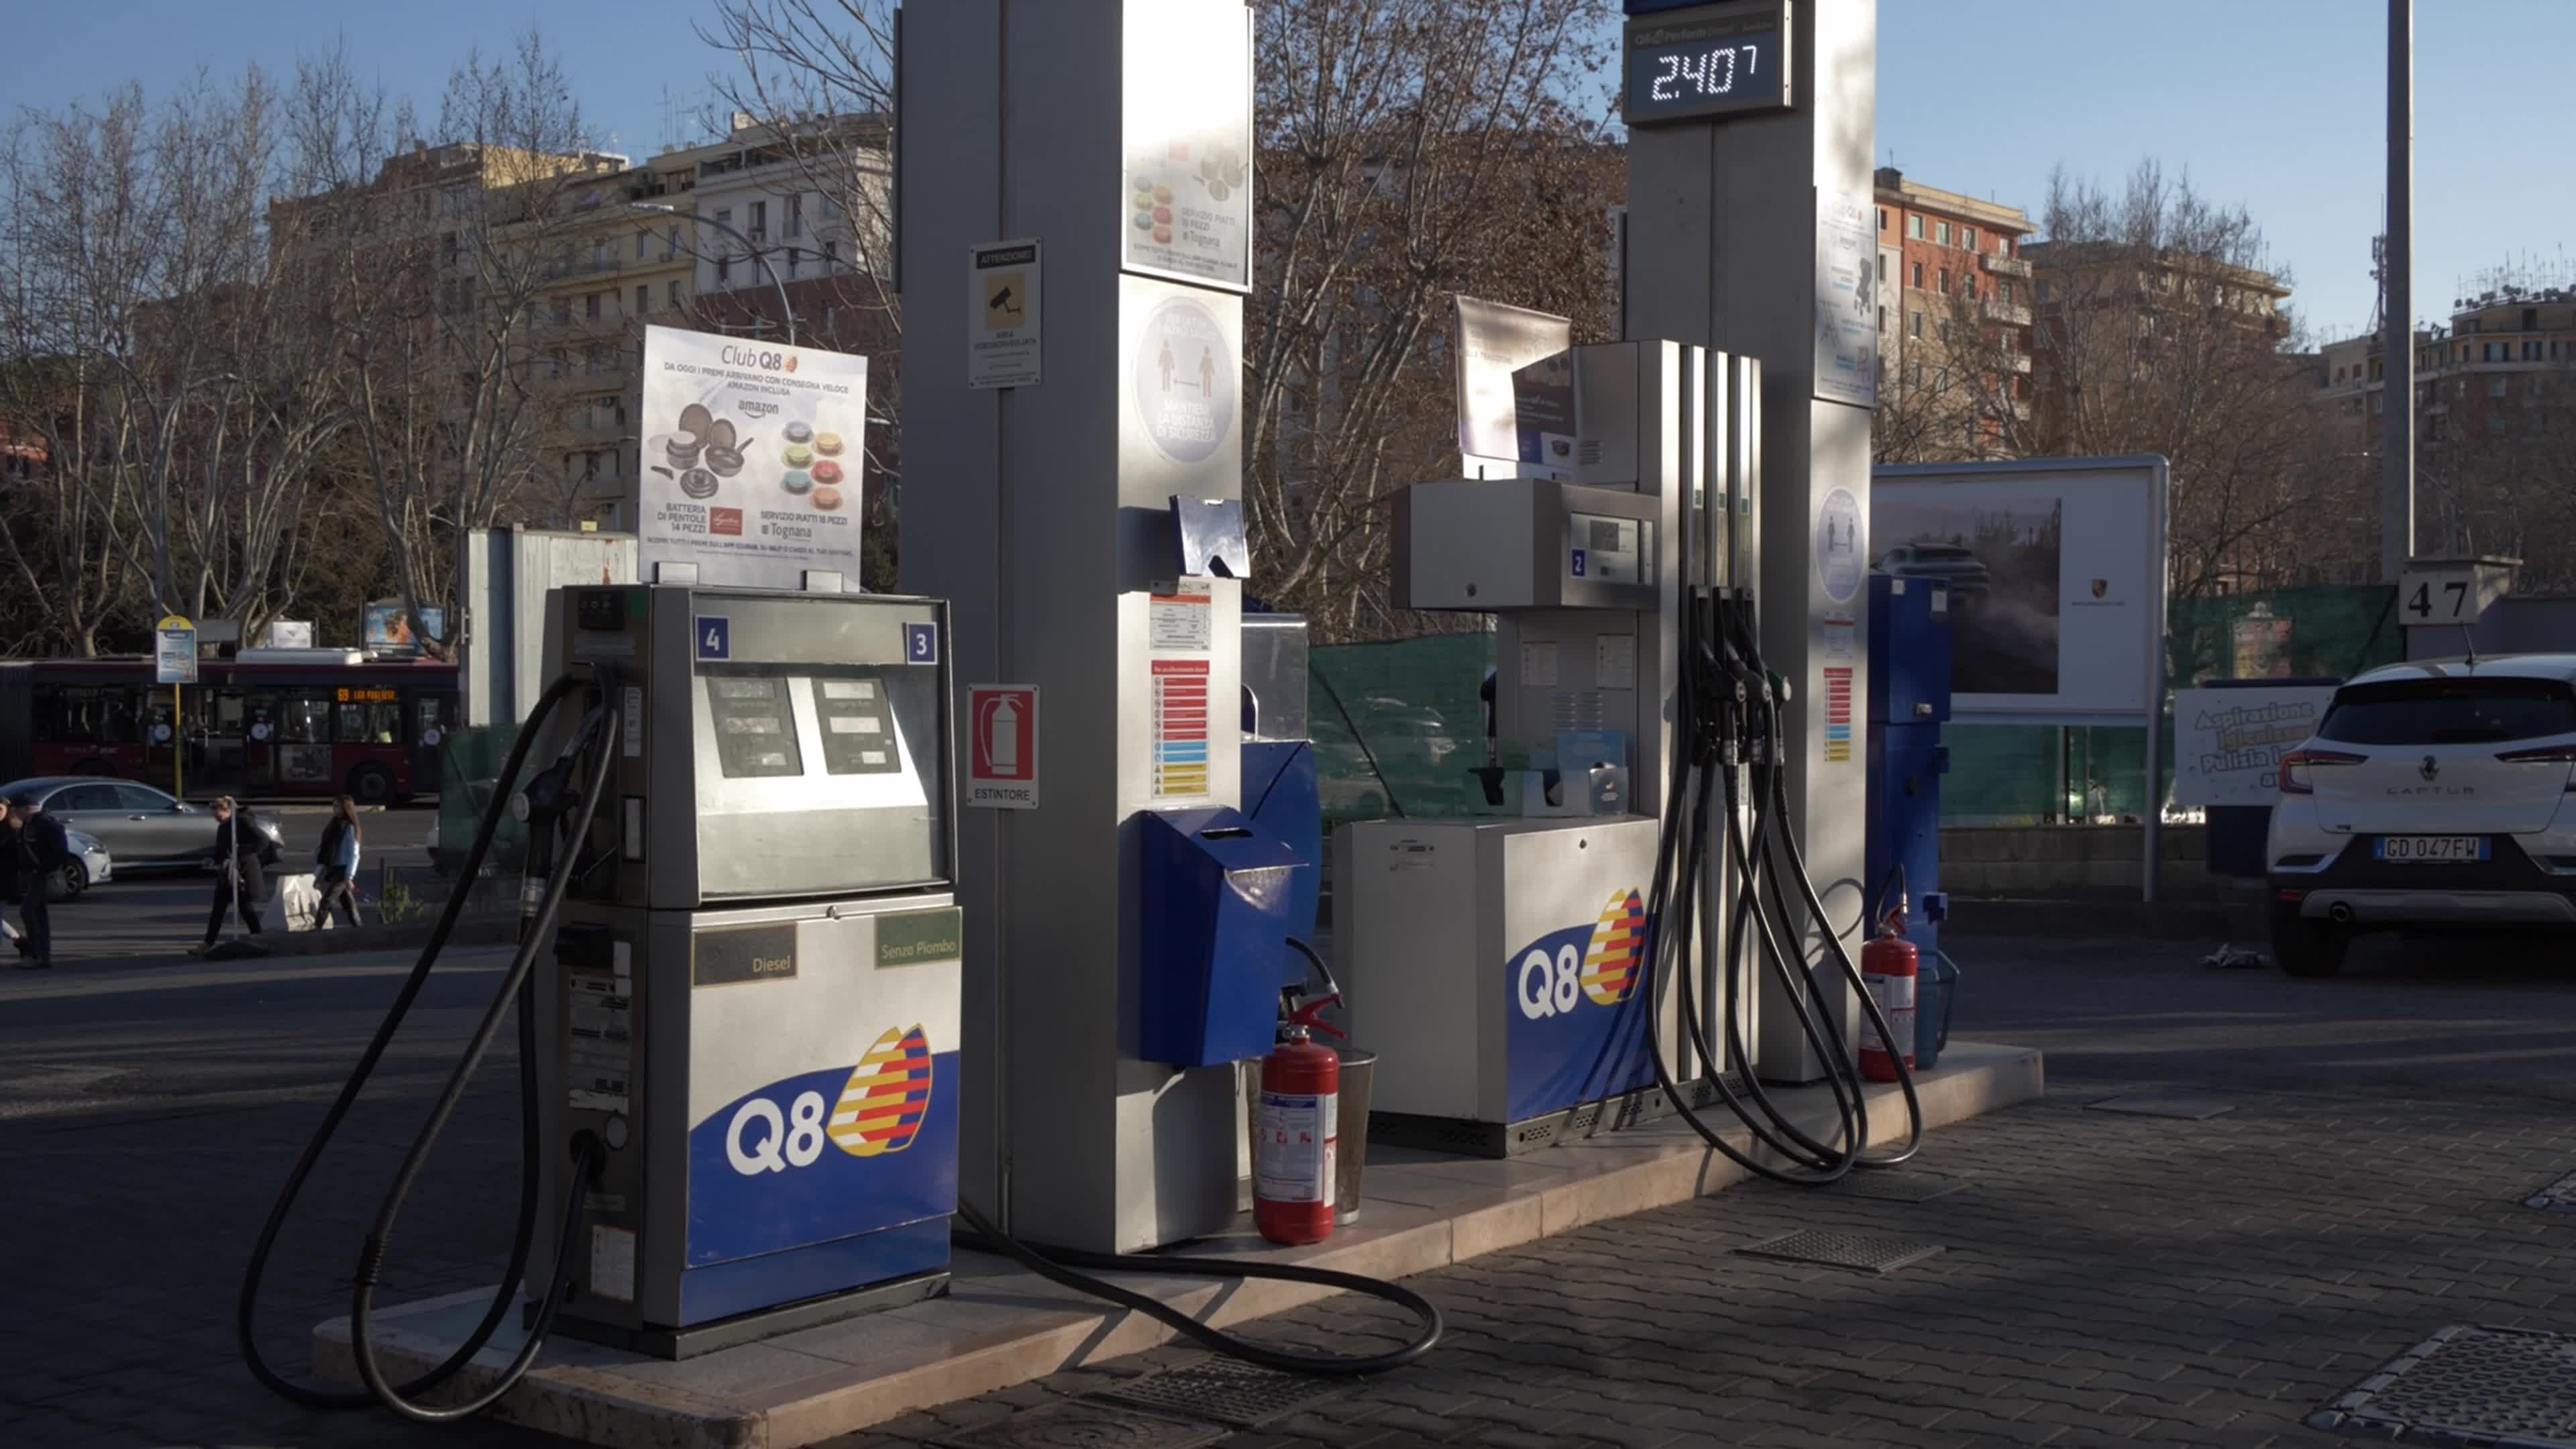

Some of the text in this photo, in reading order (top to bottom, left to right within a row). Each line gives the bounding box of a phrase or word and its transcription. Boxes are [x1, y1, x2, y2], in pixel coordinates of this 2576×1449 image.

[721, 345, 782, 370] Club Q8
[664, 362, 676, 371] DA
[678, 363, 696, 374] OGGI
[702, 366, 725, 378] PREMI
[726, 370, 764, 384] ARRIVANO
[765, 375, 781, 386] CON
[782, 377, 821, 390] CONSEGNA
[822, 382, 849, 394] VELOCE
[727, 381, 790, 396] AMAZON INCLUSA
[739, 399, 779, 415] amazon
[666, 502, 706, 515] BATTERIA
[657, 512, 706, 525] DI PENTOLE
[760, 511, 794, 522] SERVIZIO
[827, 515, 847, 526] PEZZI
[672, 523, 706, 533] 14 PEZZI
[771, 522, 812, 539] Tognana
[1574, 555, 1582, 572] 2
[2408, 582, 2468, 618] 47
[706, 628, 720, 651] 4
[916, 633, 927, 655] 3
[975, 788, 1030, 801] ESTINTORE
[2386, 786, 2475, 796] CAPTUR
[2387, 839, 2477, 857] GD 047FW
[881, 939, 956, 959] Senza Piombo
[752, 955, 792, 973] Diesel
[1518, 944, 1579, 1020] Q8
[726, 1091, 824, 1175] Q8
